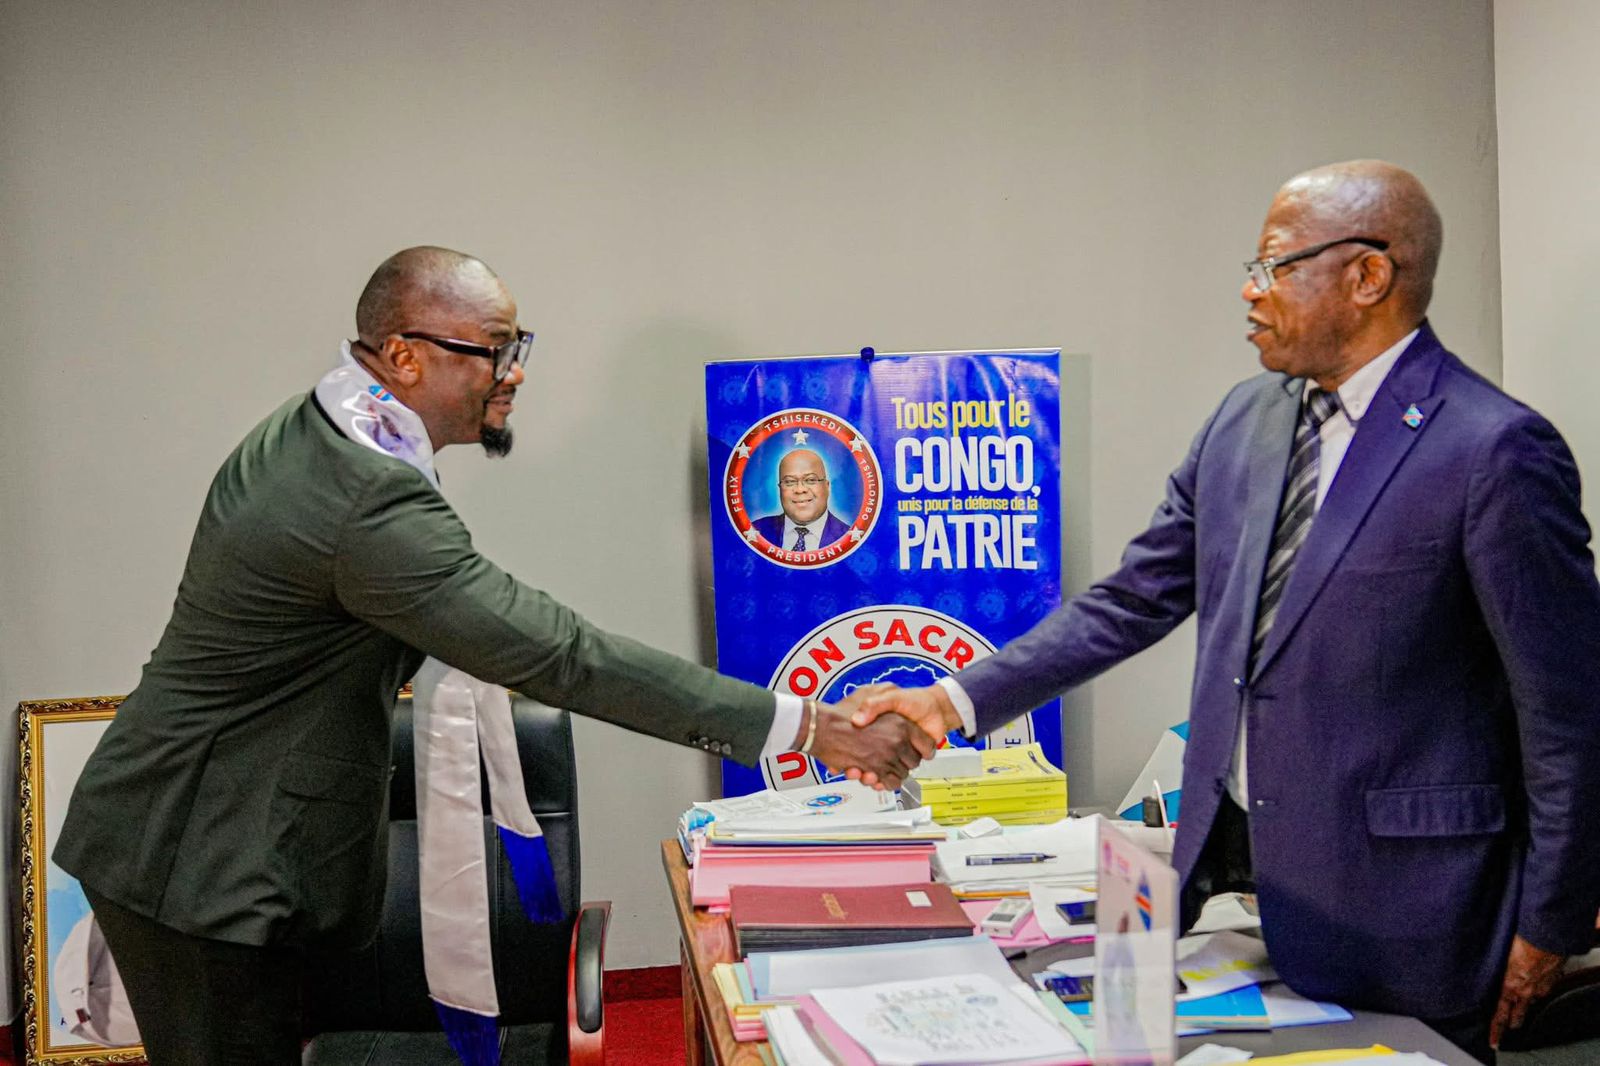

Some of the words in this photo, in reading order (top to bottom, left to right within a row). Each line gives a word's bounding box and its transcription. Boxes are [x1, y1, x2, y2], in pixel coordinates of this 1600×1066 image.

[764, 414, 842, 434] TSHISEKEDI
[892, 397, 947, 429] Tous
[952, 400, 1005, 438] pour
[1008, 393, 1030, 428] le
[859, 457, 876, 521] TSHILOMBO
[895, 435, 1041, 497] CONGO,
[729, 475, 743, 513] FELIX
[897, 497, 922, 512] unis
[924, 498, 950, 515] pour
[951, 496, 963, 511] la
[964, 495, 1009, 511] défense
[1010, 496, 1026, 511] de
[1026, 496, 1038, 511] la
[898, 513, 1038, 570] PATRIE
[853, 619, 975, 670] SACR
